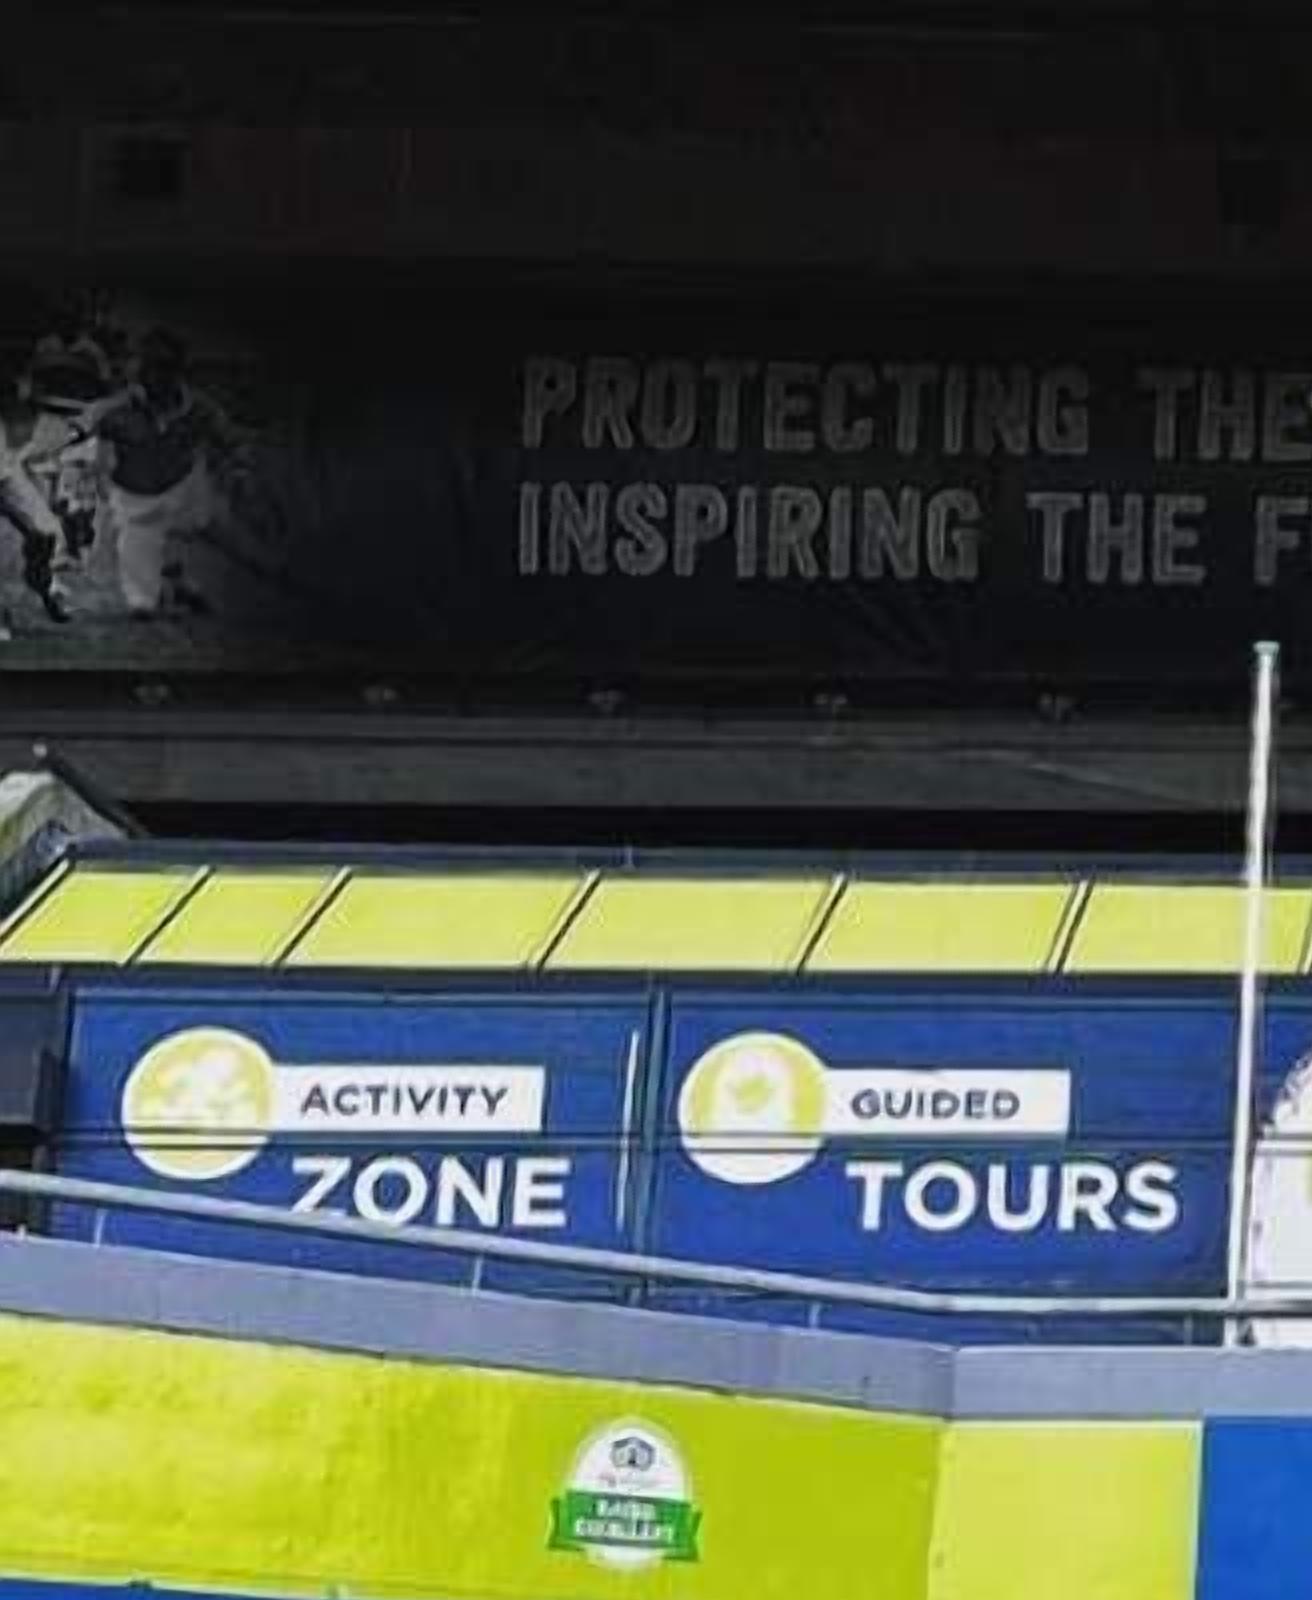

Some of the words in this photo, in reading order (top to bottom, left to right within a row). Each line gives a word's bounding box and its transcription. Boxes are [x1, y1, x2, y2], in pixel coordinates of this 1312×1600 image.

[521, 356, 1090, 455] PROTECTING
[517, 480, 982, 582] INSPIRING
[1026, 491, 1207, 585] THE
[300, 1083, 509, 1117] ACTIVITY
[850, 1087, 1022, 1120] GUIDED
[290, 1154, 572, 1229] ZONE
[845, 1159, 1179, 1234] TOURS
